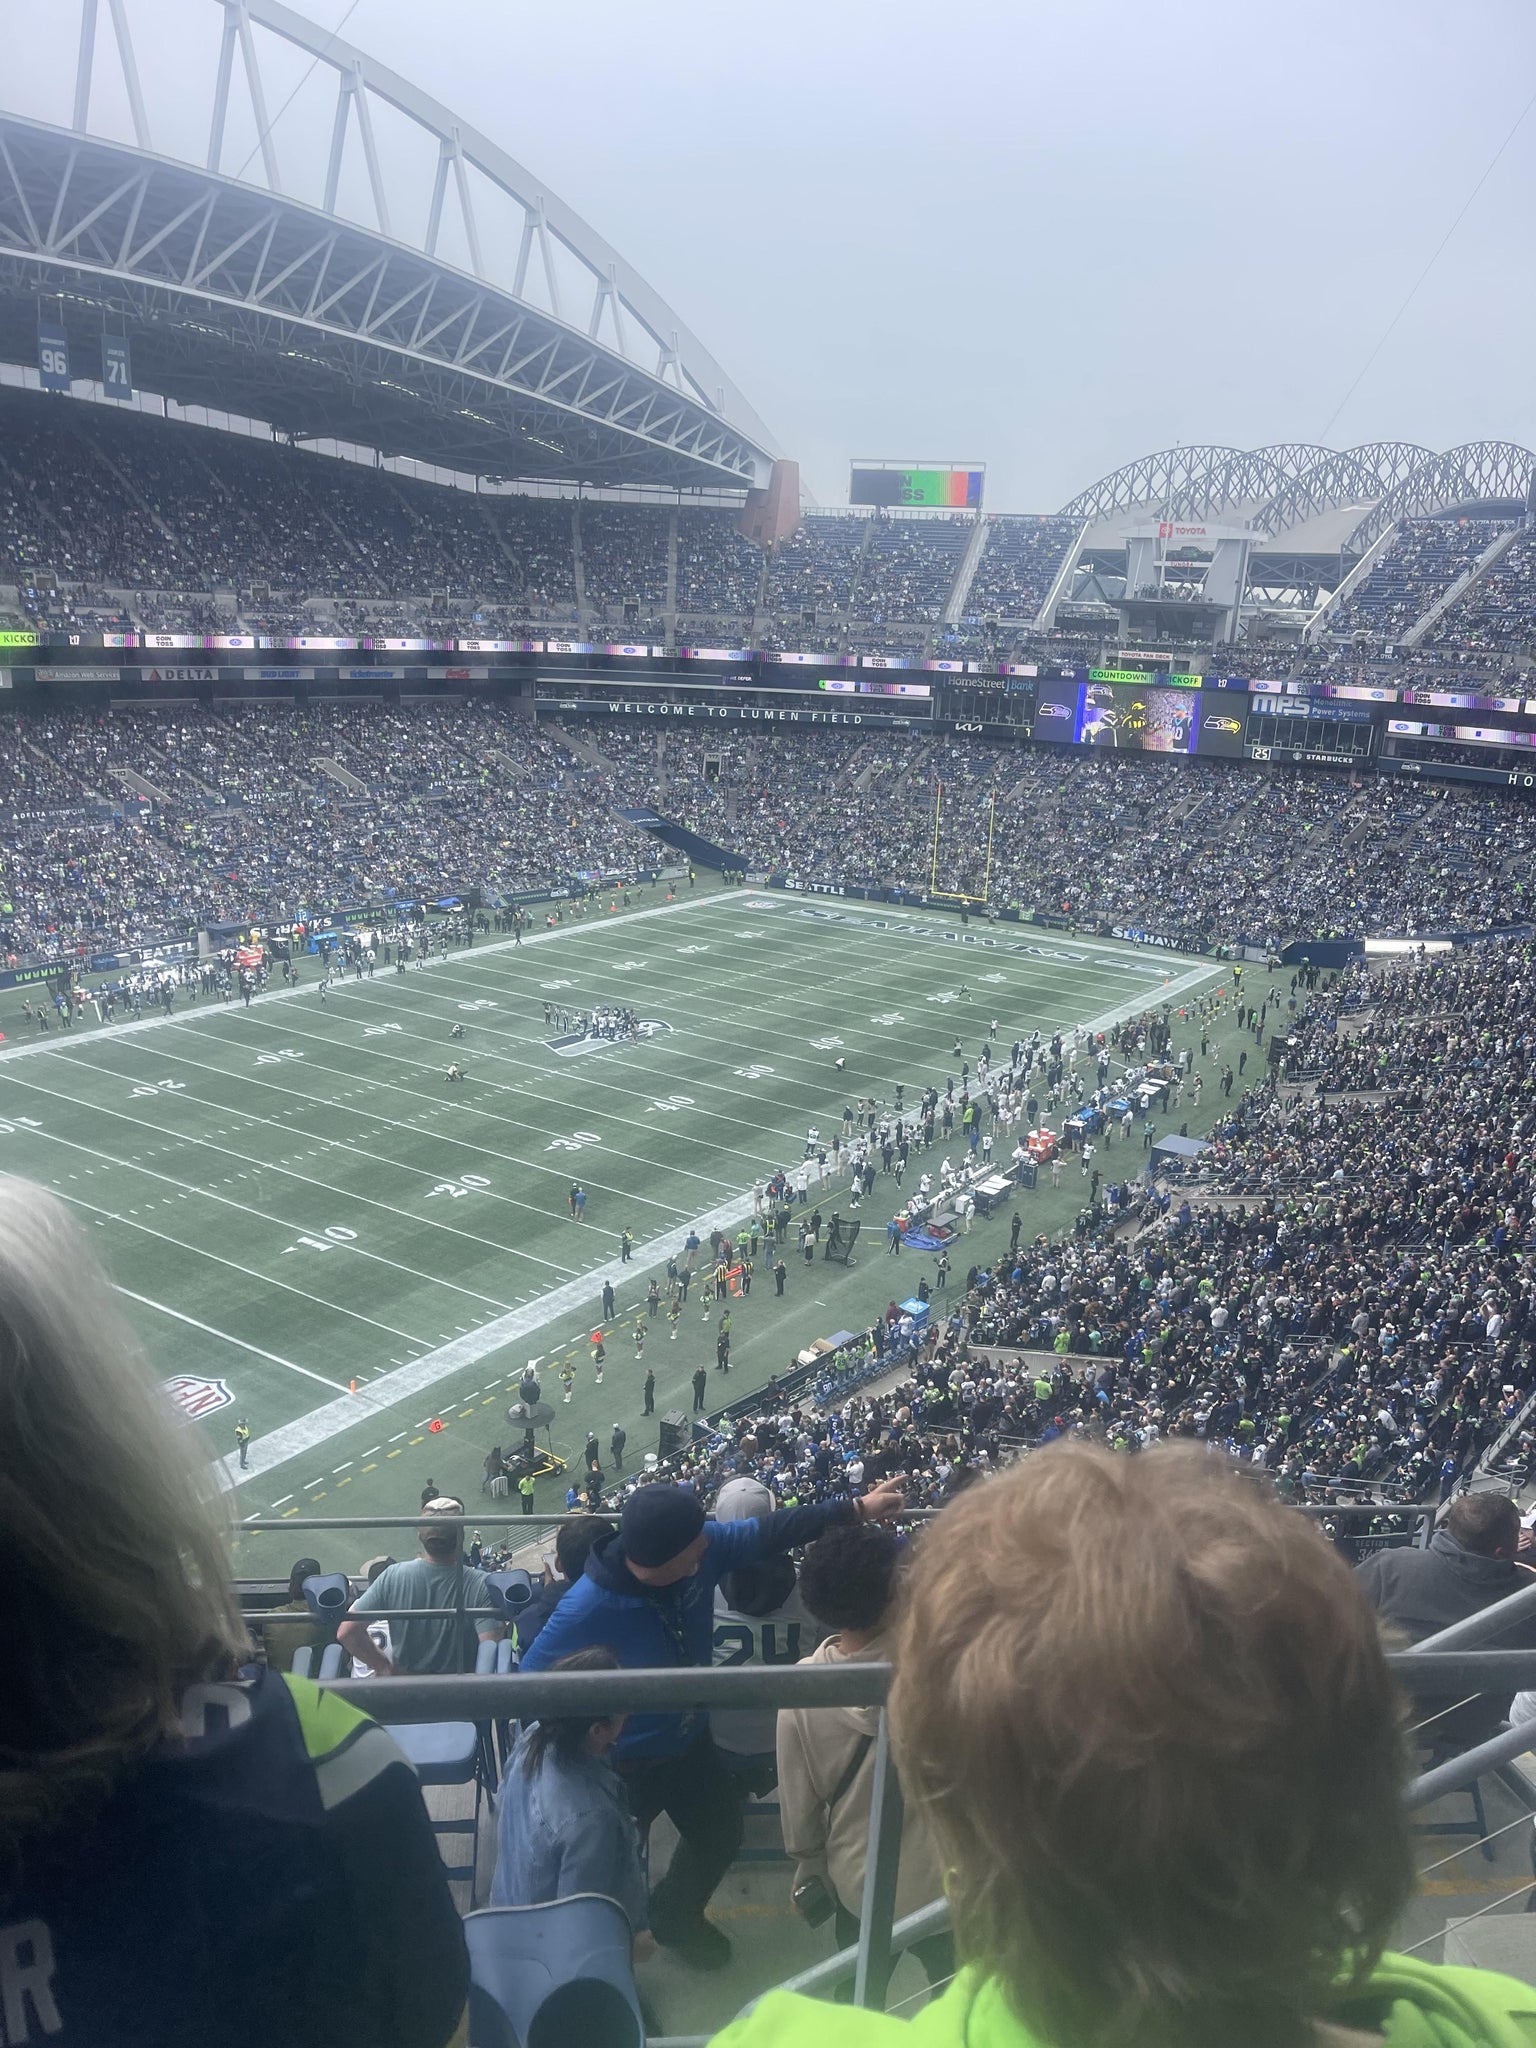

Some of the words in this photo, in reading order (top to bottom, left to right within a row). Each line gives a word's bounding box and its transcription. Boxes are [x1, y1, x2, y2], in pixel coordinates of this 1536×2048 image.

[41, 349, 67, 375] 96
[106, 359, 128, 385] 71
[1175, 527, 1207, 536] TOYOTA
[3, 633, 39, 644] KICKO
[54, 671, 80, 679] Amazon
[81, 671, 95, 679] Web
[96, 671, 120, 679] Services
[165, 669, 213, 680] DELTA
[278, 671, 299, 679] LIGHT
[1092, 670, 1147, 681] COUNTDOWN
[1170, 675, 1199, 685] ICKOFF
[948, 676, 1006, 689] HomeStreet
[1010, 680, 1034, 691] Bank
[1251, 694, 1311, 715] MPS
[1313, 698, 1353, 708] Monolithic
[609, 703, 696, 716] WELCOME
[707, 707, 728, 717] TO
[740, 710, 799, 721] LUMEN
[812, 713, 862, 724] FIELD
[1312, 707, 1336, 717] Power
[1338, 709, 1371, 719] Systems
[1254, 751, 1268, 759] 25
[1306, 754, 1354, 764] STARBUCKS
[1508, 774, 1534, 787] HO
[20, 811, 47, 819] DELTA
[784, 878, 845, 896] SEATTLE
[809, 1036, 845, 1051] 40
[257, 1049, 305, 1064] 30
[732, 1064, 775, 1080] 50
[132, 1079, 186, 1097] 20
[653, 1095, 696, 1113] 40
[552, 1131, 602, 1152] 30
[433, 1174, 491, 1199] 20
[297, 1226, 358, 1252] 10
[434, 1420, 441, 1431] G
[1355, 1539, 1390, 1547] SECTION
